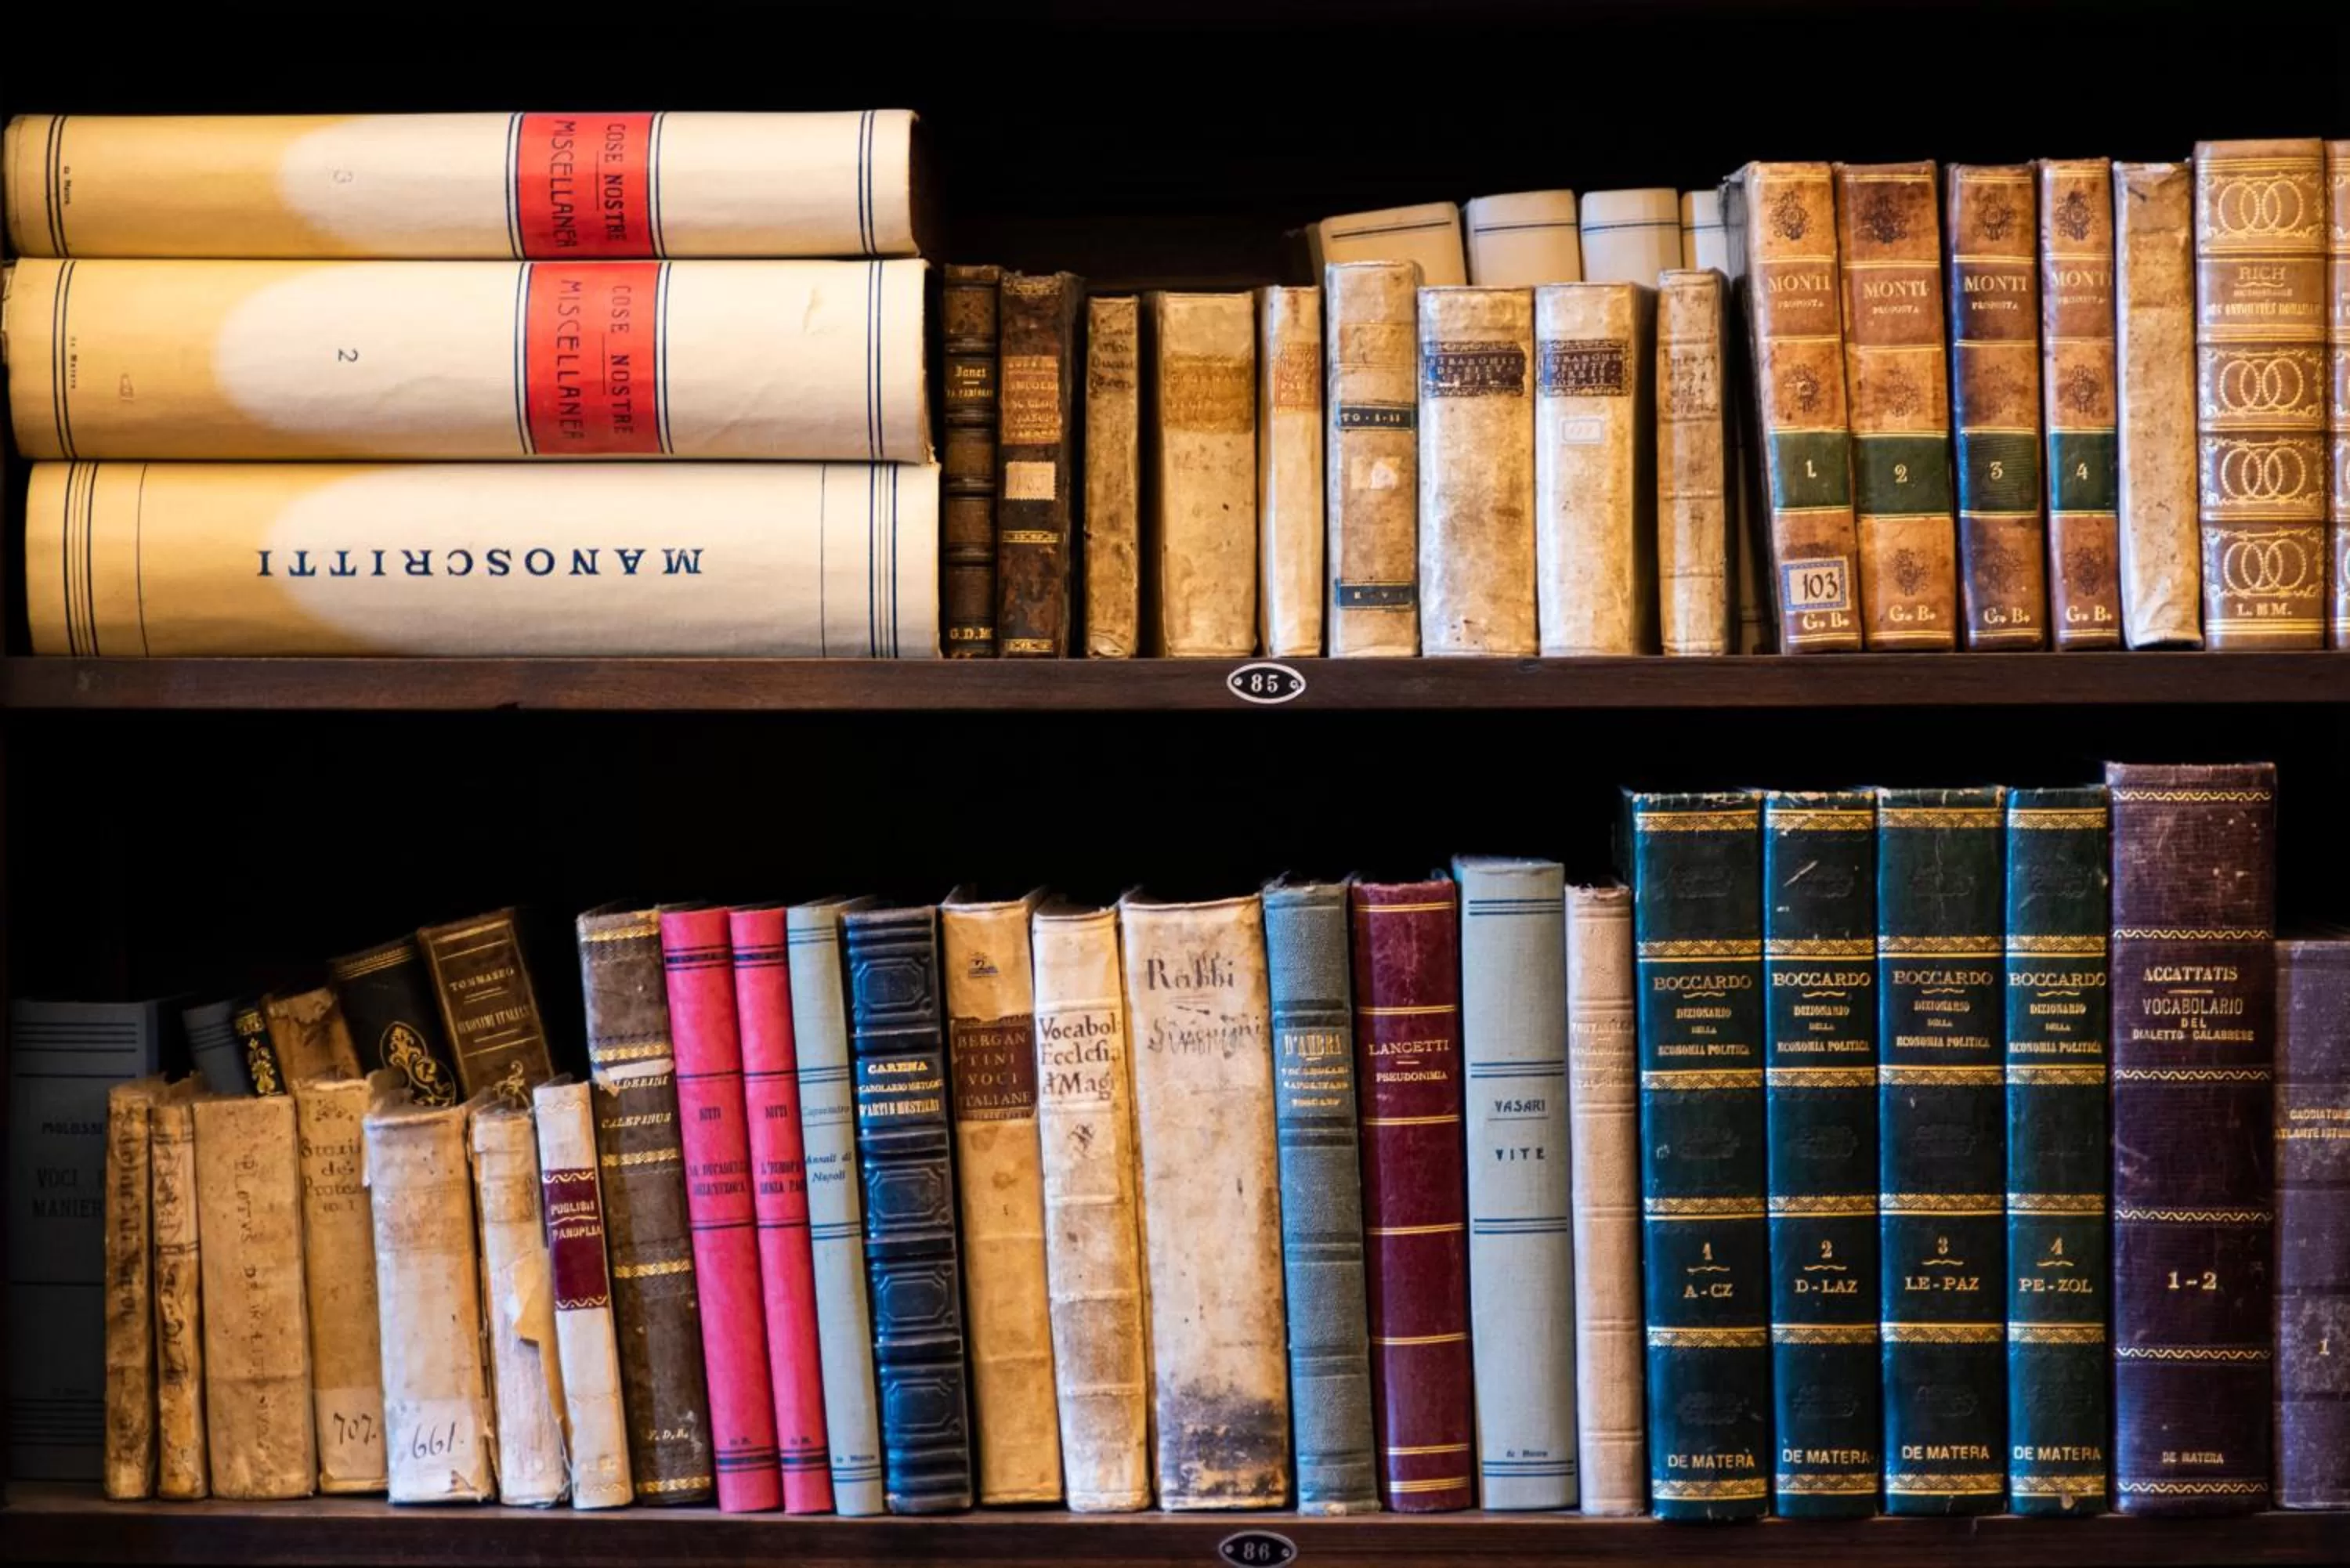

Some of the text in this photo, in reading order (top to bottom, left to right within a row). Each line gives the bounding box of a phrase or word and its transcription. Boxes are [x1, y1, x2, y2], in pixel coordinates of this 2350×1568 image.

[603, 123, 625, 242] COSE NOSTRE
[2053, 271, 2113, 287] MONTI
[2239, 266, 2286, 280] RICH
[1768, 275, 1831, 293] MONTI
[1863, 280, 1929, 298] MONTI
[1965, 276, 2027, 292] MONTI
[338, 349, 358, 363] 2
[556, 280, 585, 440] MISCELLANEA
[610, 284, 633, 434] COSE NOSTRE
[1805, 460, 1817, 479] 1
[1894, 464, 1908, 483] 2
[1989, 461, 2004, 480] 3
[2075, 462, 2088, 480] 4
[256, 548, 704, 578] MANOSCRITTI
[1803, 571, 1838, 600] 103
[1251, 674, 1278, 692] 85
[1772, 972, 1871, 987] BOCCARDO
[1892, 970, 1994, 985] BOCCARDO
[2008, 972, 2106, 987] BOCCARDO
[2143, 966, 2238, 982] ACCATTATIS
[1654, 975, 1752, 991] BOCCARDO
[2142, 998, 2243, 1015] VOCABOLARIO
[2180, 1017, 2207, 1028] DEL
[957, 1032, 1027, 1048] BERGAN
[2132, 1029, 2254, 1041] DIALETTO CALABRESE
[1368, 1039, 1451, 1056] LANCETTI
[968, 1053, 1015, 1066] TINI
[968, 1073, 1018, 1086] VOCI
[1376, 1071, 1448, 1083] PSEUDONIMIA
[1495, 1100, 1546, 1113] VASARI
[1495, 1147, 1545, 1161] VITE
[1702, 1241, 1713, 1260] 1
[1820, 1239, 1833, 1259] 2
[1937, 1236, 1949, 1255] 3
[2319, 1338, 2330, 1355] 1
[1668, 1453, 1755, 1469] DE MATERA
[1782, 1448, 1868, 1464] DE MATERA
[1901, 1445, 1990, 1461] DE MATERA
[2013, 1446, 2102, 1461] DE MATERA
[1243, 1541, 1270, 1560] 86
